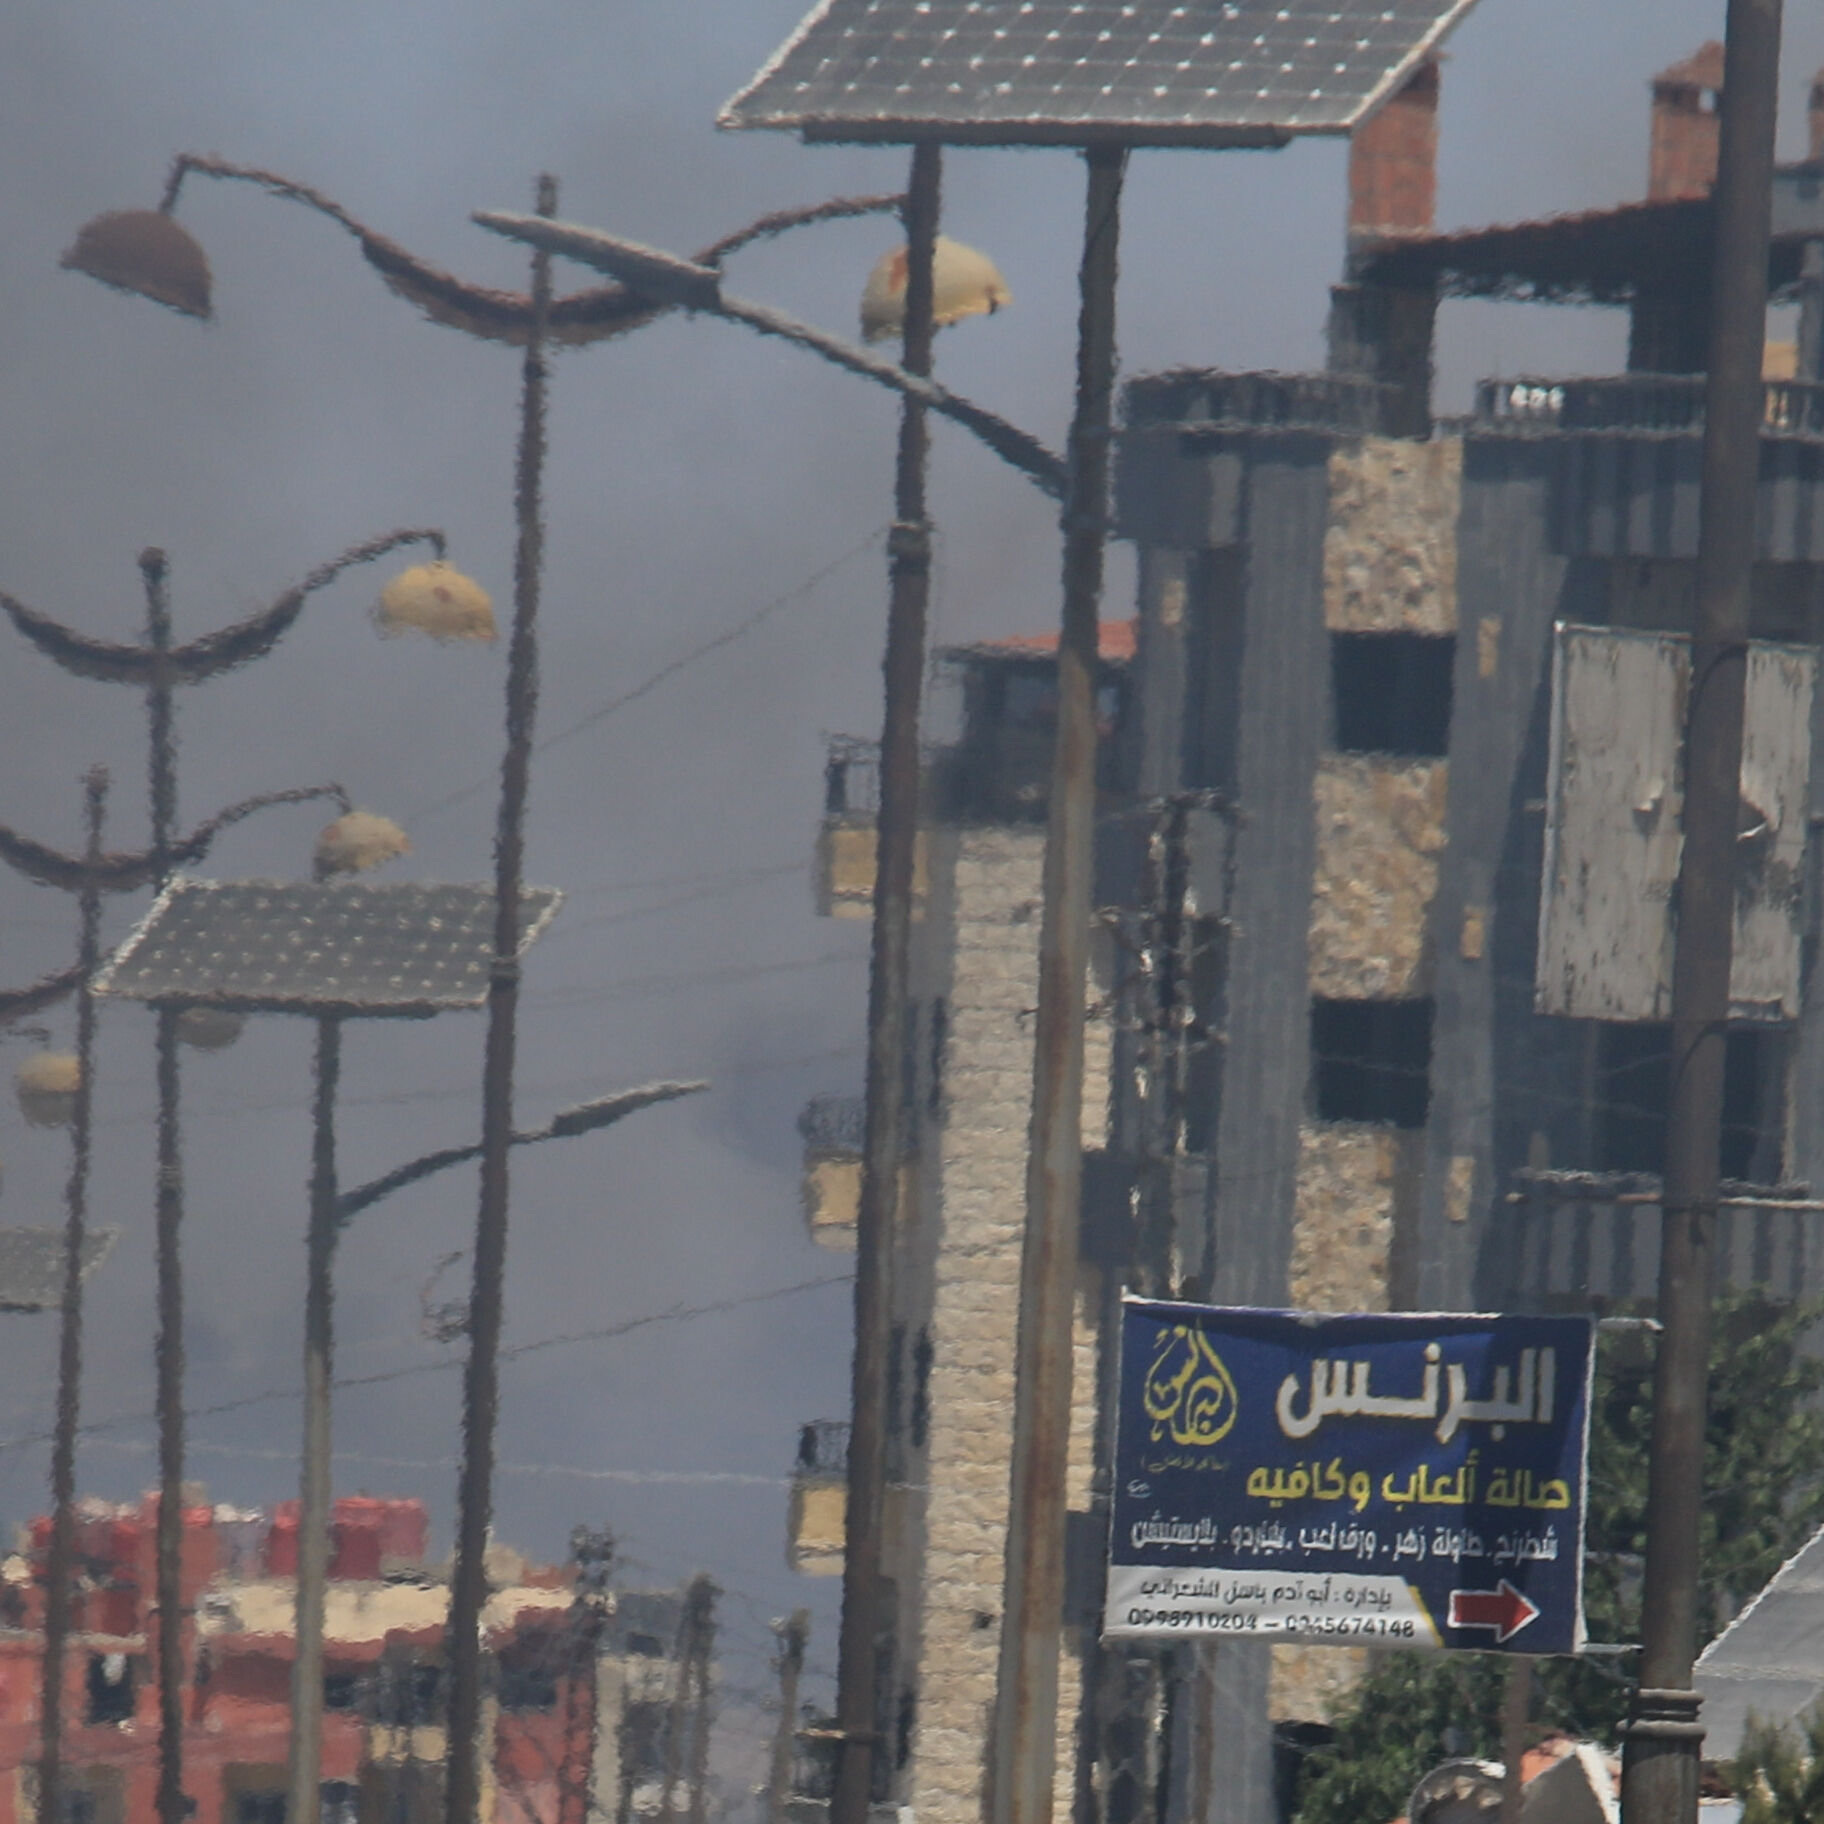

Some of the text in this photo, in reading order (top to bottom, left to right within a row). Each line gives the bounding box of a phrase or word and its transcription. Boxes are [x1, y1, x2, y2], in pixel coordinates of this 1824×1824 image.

[1277, 1341, 1558, 1442] البرنس
[1246, 1449, 1572, 1513] صالة ألعاب وكافيه
[1298, 1521, 1337, 1557] لعب
[1340, 1522, 1377, 1560] ورق
[1391, 1524, 1426, 1562] زهر
